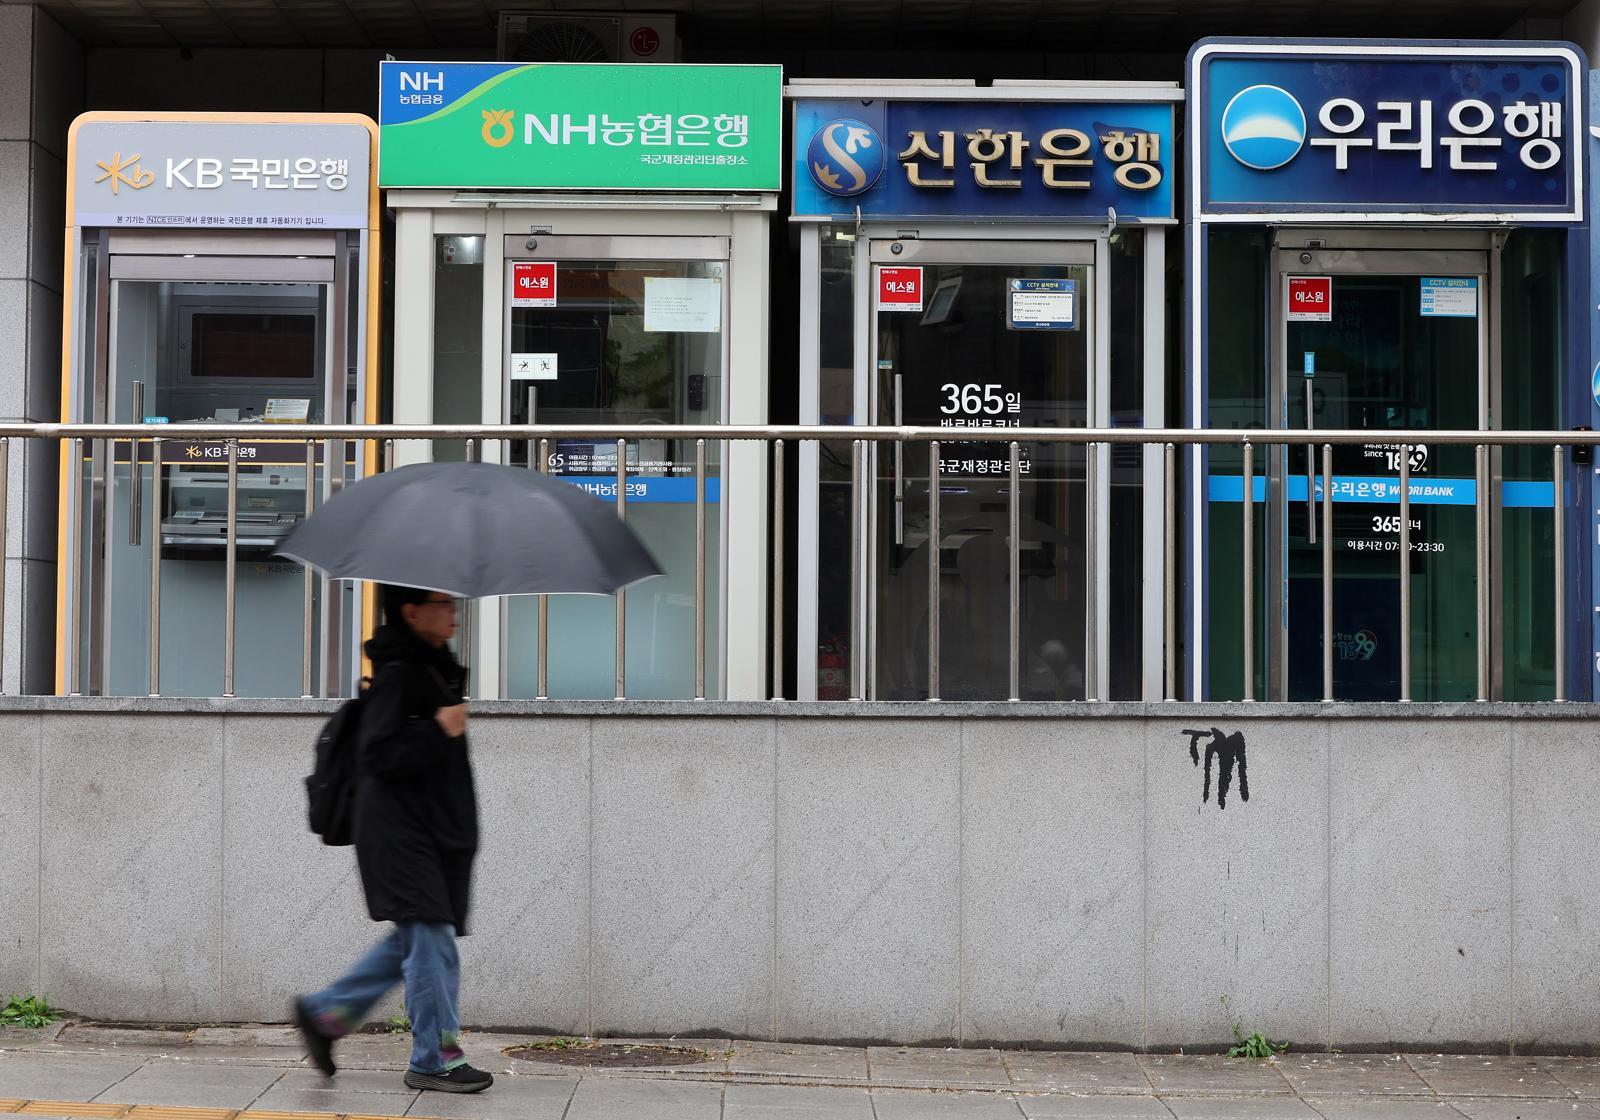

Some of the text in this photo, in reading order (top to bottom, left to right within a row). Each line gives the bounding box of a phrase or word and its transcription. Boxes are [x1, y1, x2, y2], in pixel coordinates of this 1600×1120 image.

[400, 71, 443, 91] NH
[400, 94, 443, 105] 농협금융
[523, 113, 748, 147] NH농협은행
[1310, 98, 1561, 170] 우리은행
[640, 154, 748, 165] 국군재정관리단출장소
[897, 128, 1162, 191] 신한은행
[117, 216, 123, 224] 본
[126, 216, 145, 224] 기기는
[200, 216, 225, 224] 운영하는
[228, 216, 253, 224] 국민은행
[271, 217, 303, 225] 자동화기기
[520, 277, 549, 288] 에스원
[886, 281, 915, 293] 에스원
[1295, 291, 1324, 303] 에스원
[548, 452, 564, 467] 65
[1424, 487, 1455, 496] BANK
[1347, 540, 1383, 551] 이용시간
